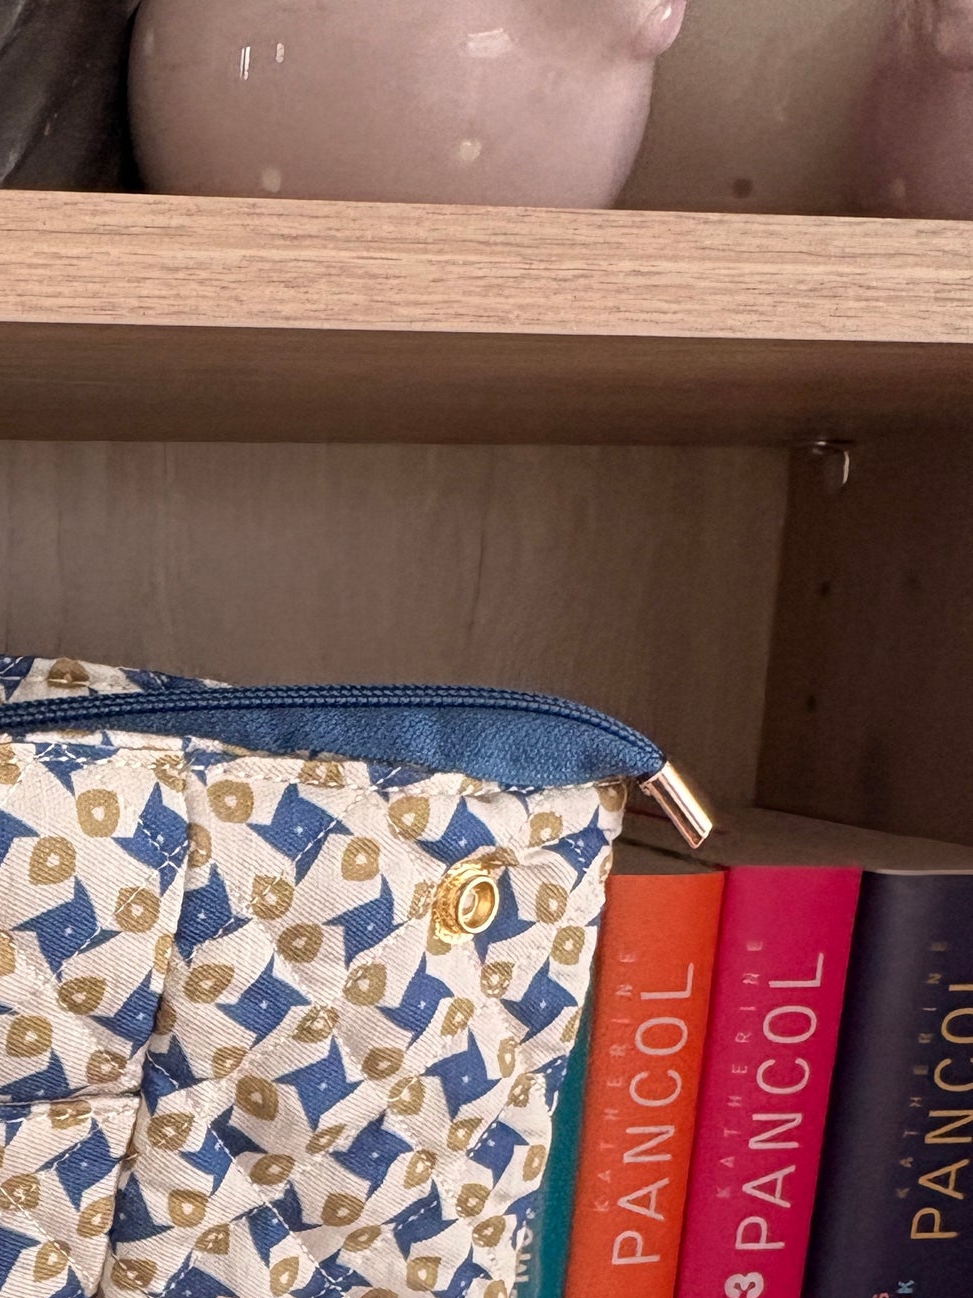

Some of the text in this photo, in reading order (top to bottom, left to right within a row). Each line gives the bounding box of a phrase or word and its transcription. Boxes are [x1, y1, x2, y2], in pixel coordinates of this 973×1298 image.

[595, 951, 636, 1212] KATHERINE
[612, 962, 694, 1265] PANCOL
[717, 941, 763, 1198] KATHERINE
[735, 952, 824, 1250] PANCOL
